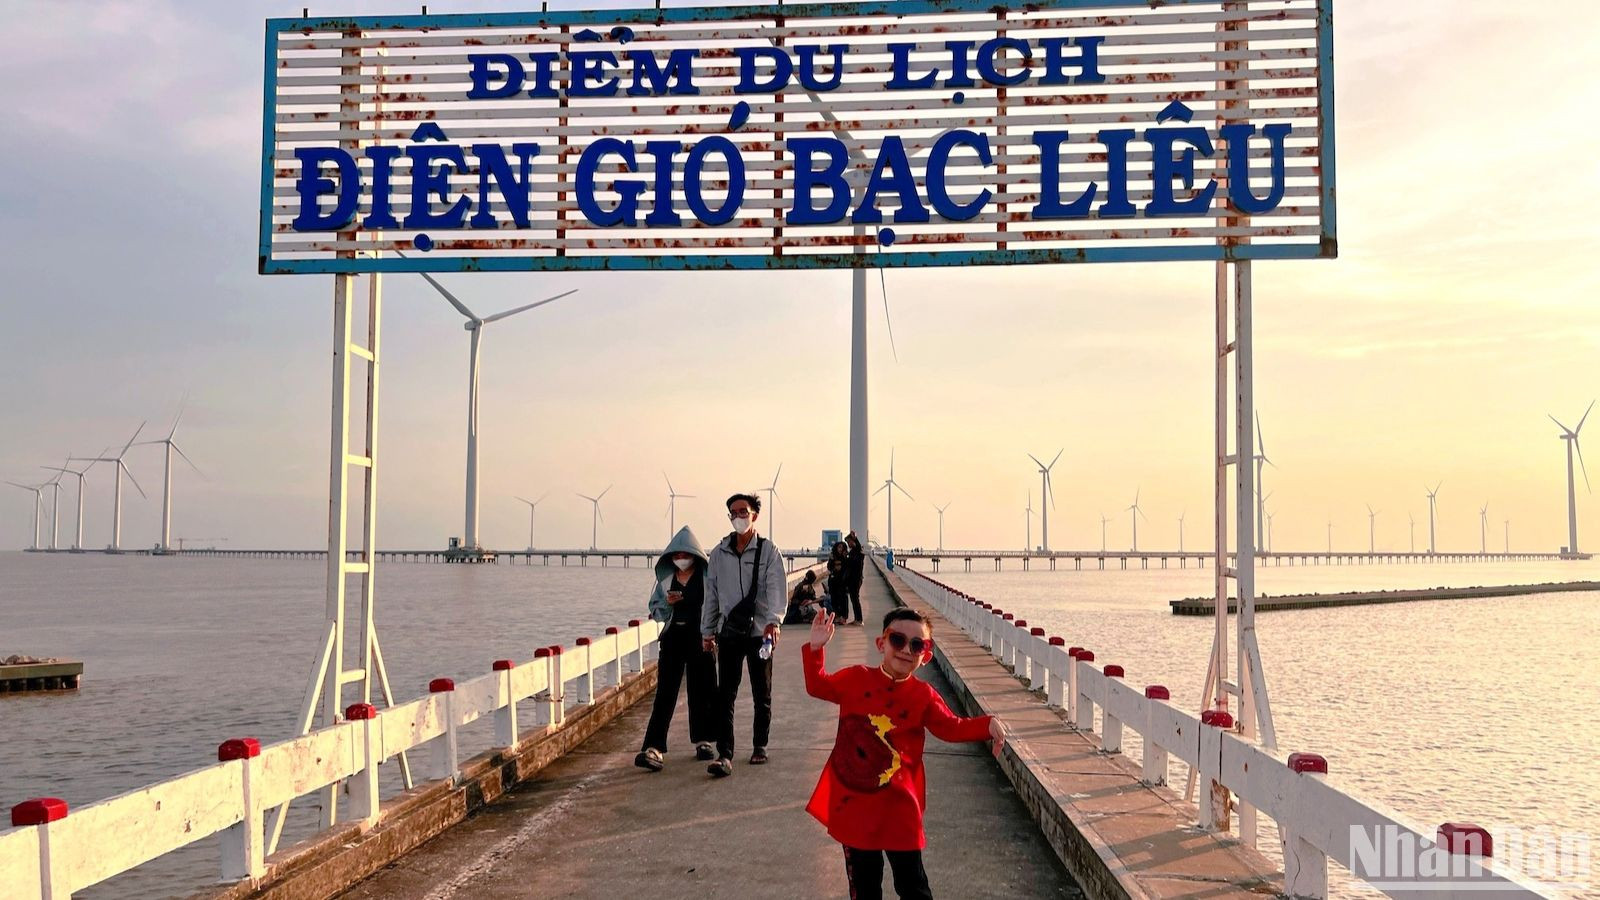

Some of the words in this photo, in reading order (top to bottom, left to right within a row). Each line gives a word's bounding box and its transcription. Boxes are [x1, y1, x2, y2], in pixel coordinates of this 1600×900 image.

[467, 26, 700, 99] ĐIỂM
[733, 44, 849, 93] DU
[886, 36, 1106, 105] LỊCH
[292, 122, 541, 252] ĐIỆN
[575, 101, 751, 227] GIÓ
[786, 129, 994, 247] BẠC
[1031, 100, 1292, 219] LIÊU
